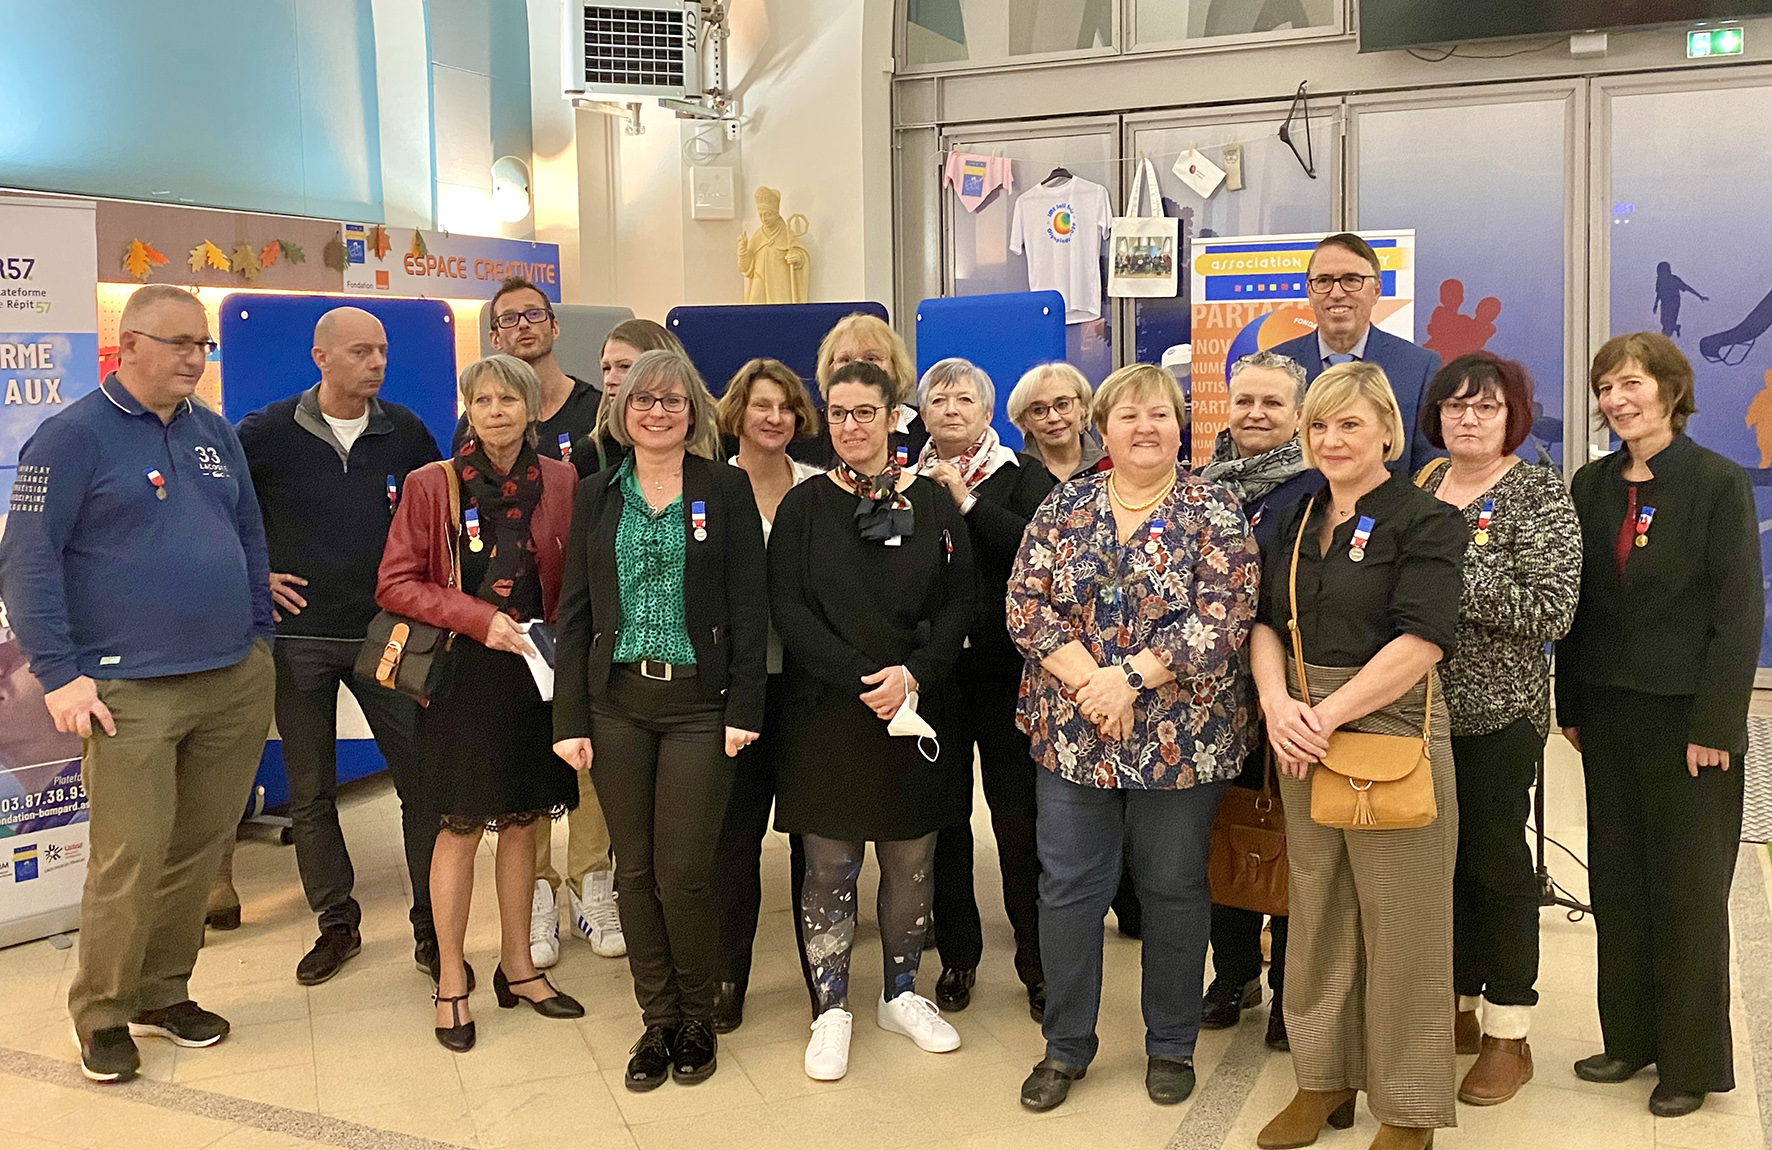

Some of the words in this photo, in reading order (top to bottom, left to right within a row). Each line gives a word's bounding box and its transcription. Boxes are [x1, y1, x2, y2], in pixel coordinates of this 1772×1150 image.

[686, 10, 697, 53] CIAT
[403, 252, 467, 279] ESPACE
[473, 258, 556, 284] CREATIVITE
[1211, 256, 1302, 271] association
[0, 287, 47, 298] ateforme
[346, 280, 374, 289] Fondation
[1191, 302, 1309, 329] PARTA
[0, 342, 54, 370] RME
[4, 377, 62, 406] AUX
[1191, 381, 1229, 394] AUTIS
[1191, 400, 1230, 415] PART
[194, 446, 220, 464] 33
[0, 800, 91, 826] ndation-bompard.as
